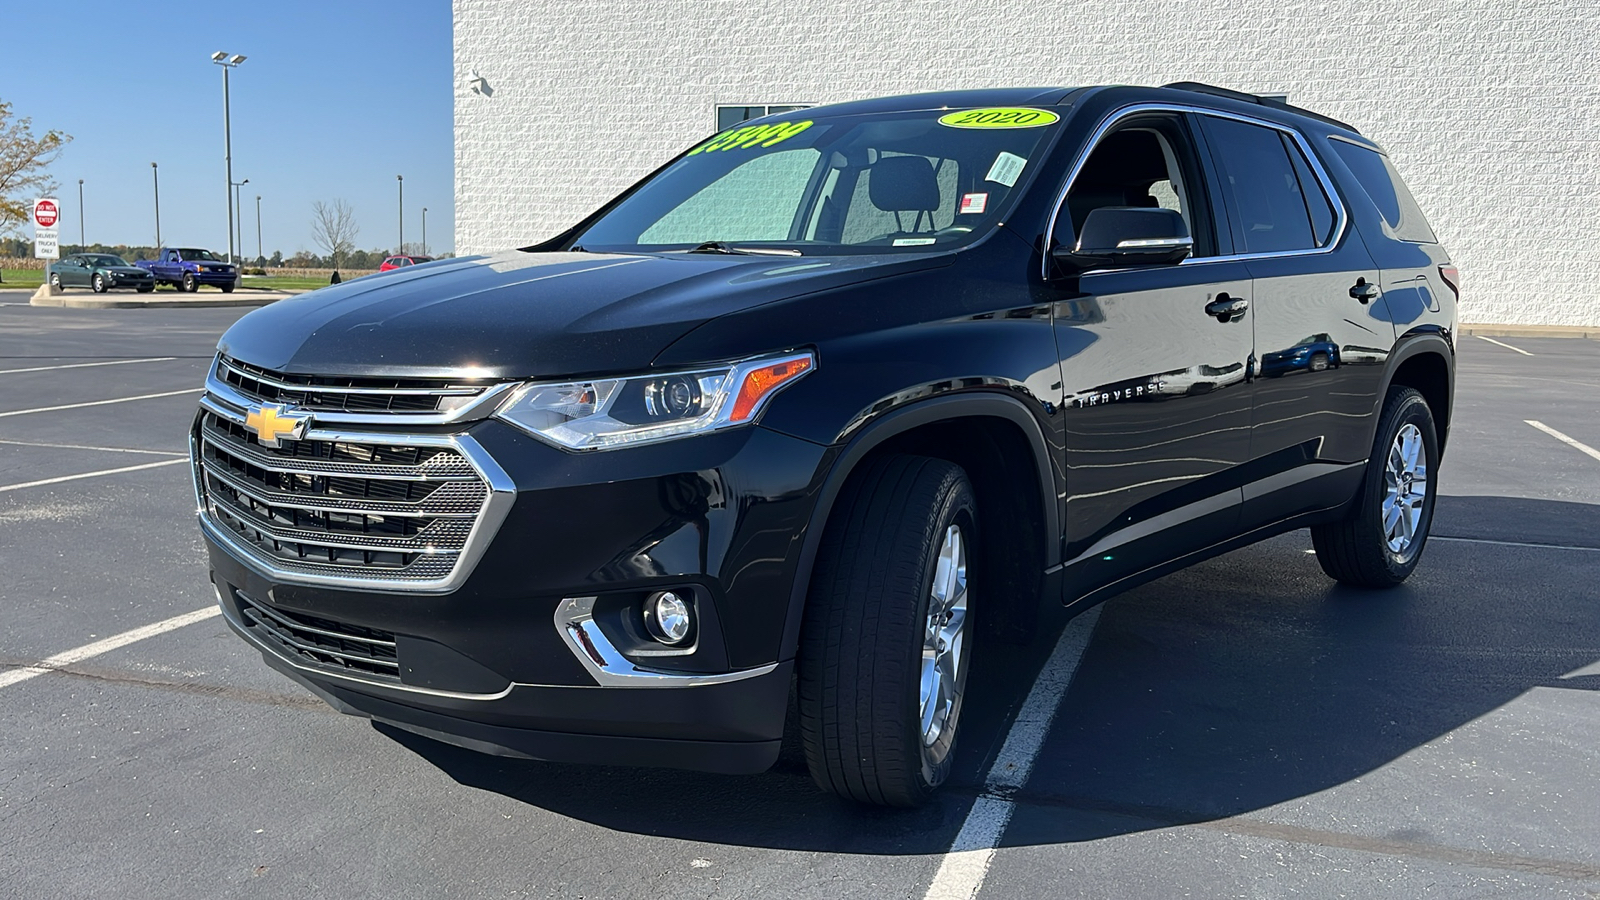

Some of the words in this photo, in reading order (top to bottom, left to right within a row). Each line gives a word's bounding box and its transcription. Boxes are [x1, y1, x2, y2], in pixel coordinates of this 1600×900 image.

[954, 112, 1041, 124] 2020
[687, 120, 814, 156] 25999
[1078, 381, 1166, 409] TRAVERSE
